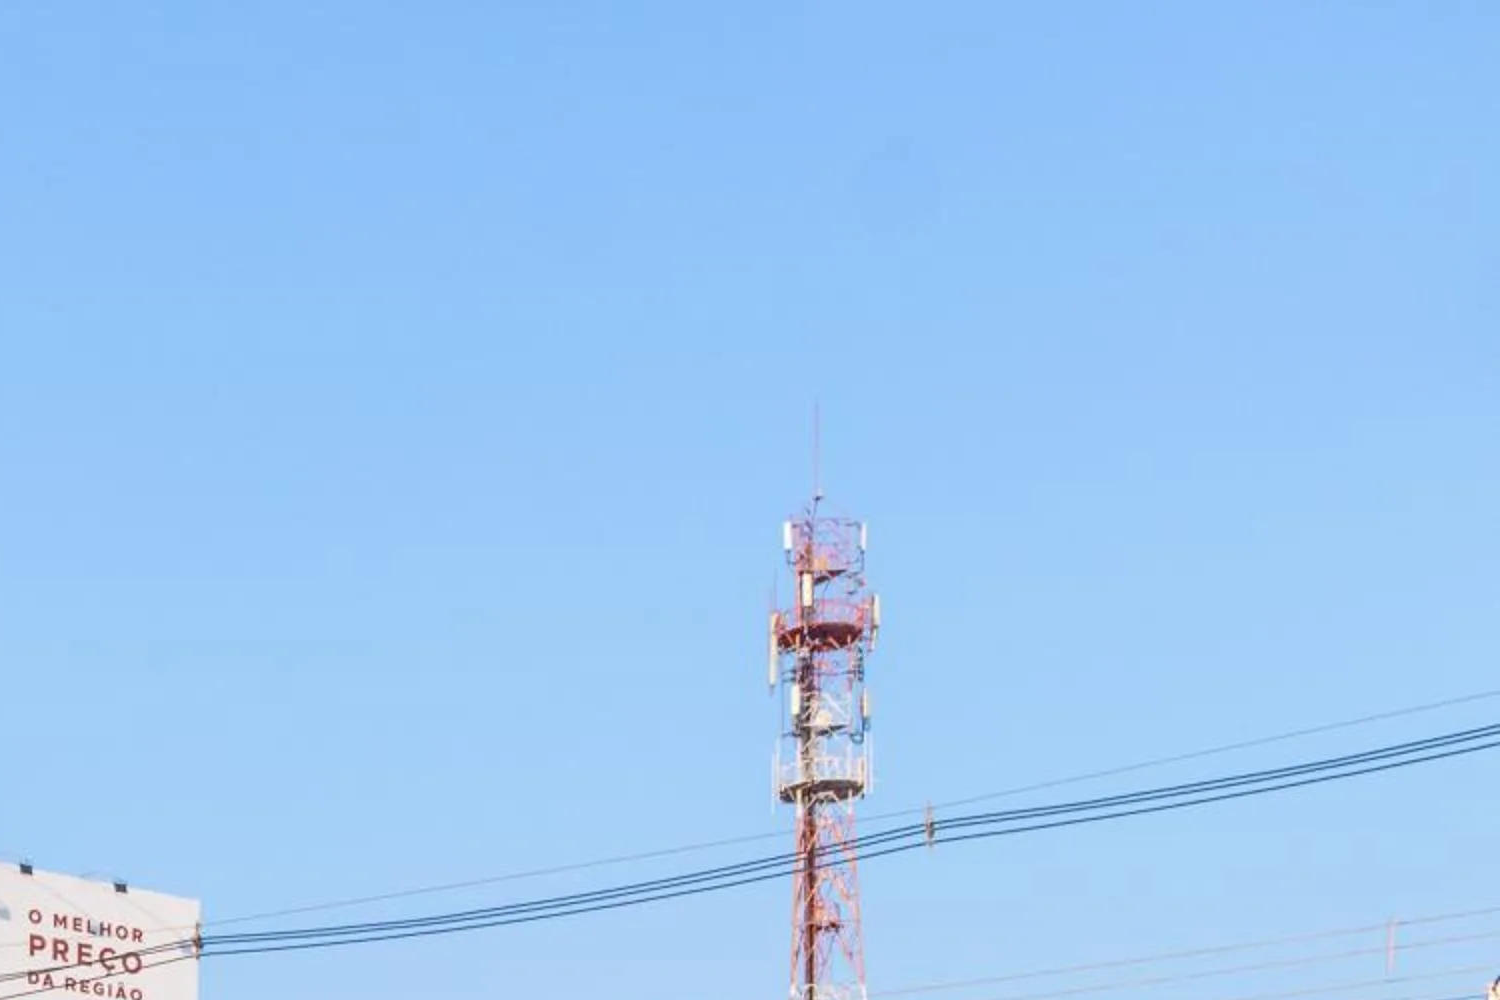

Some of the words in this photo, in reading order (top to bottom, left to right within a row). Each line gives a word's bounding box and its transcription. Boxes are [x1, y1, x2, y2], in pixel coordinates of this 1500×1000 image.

[28, 909, 42, 924] O
[53, 913, 144, 943] MELHOR
[29, 933, 143, 976] PREÇO
[27, 971, 54, 988] DA
